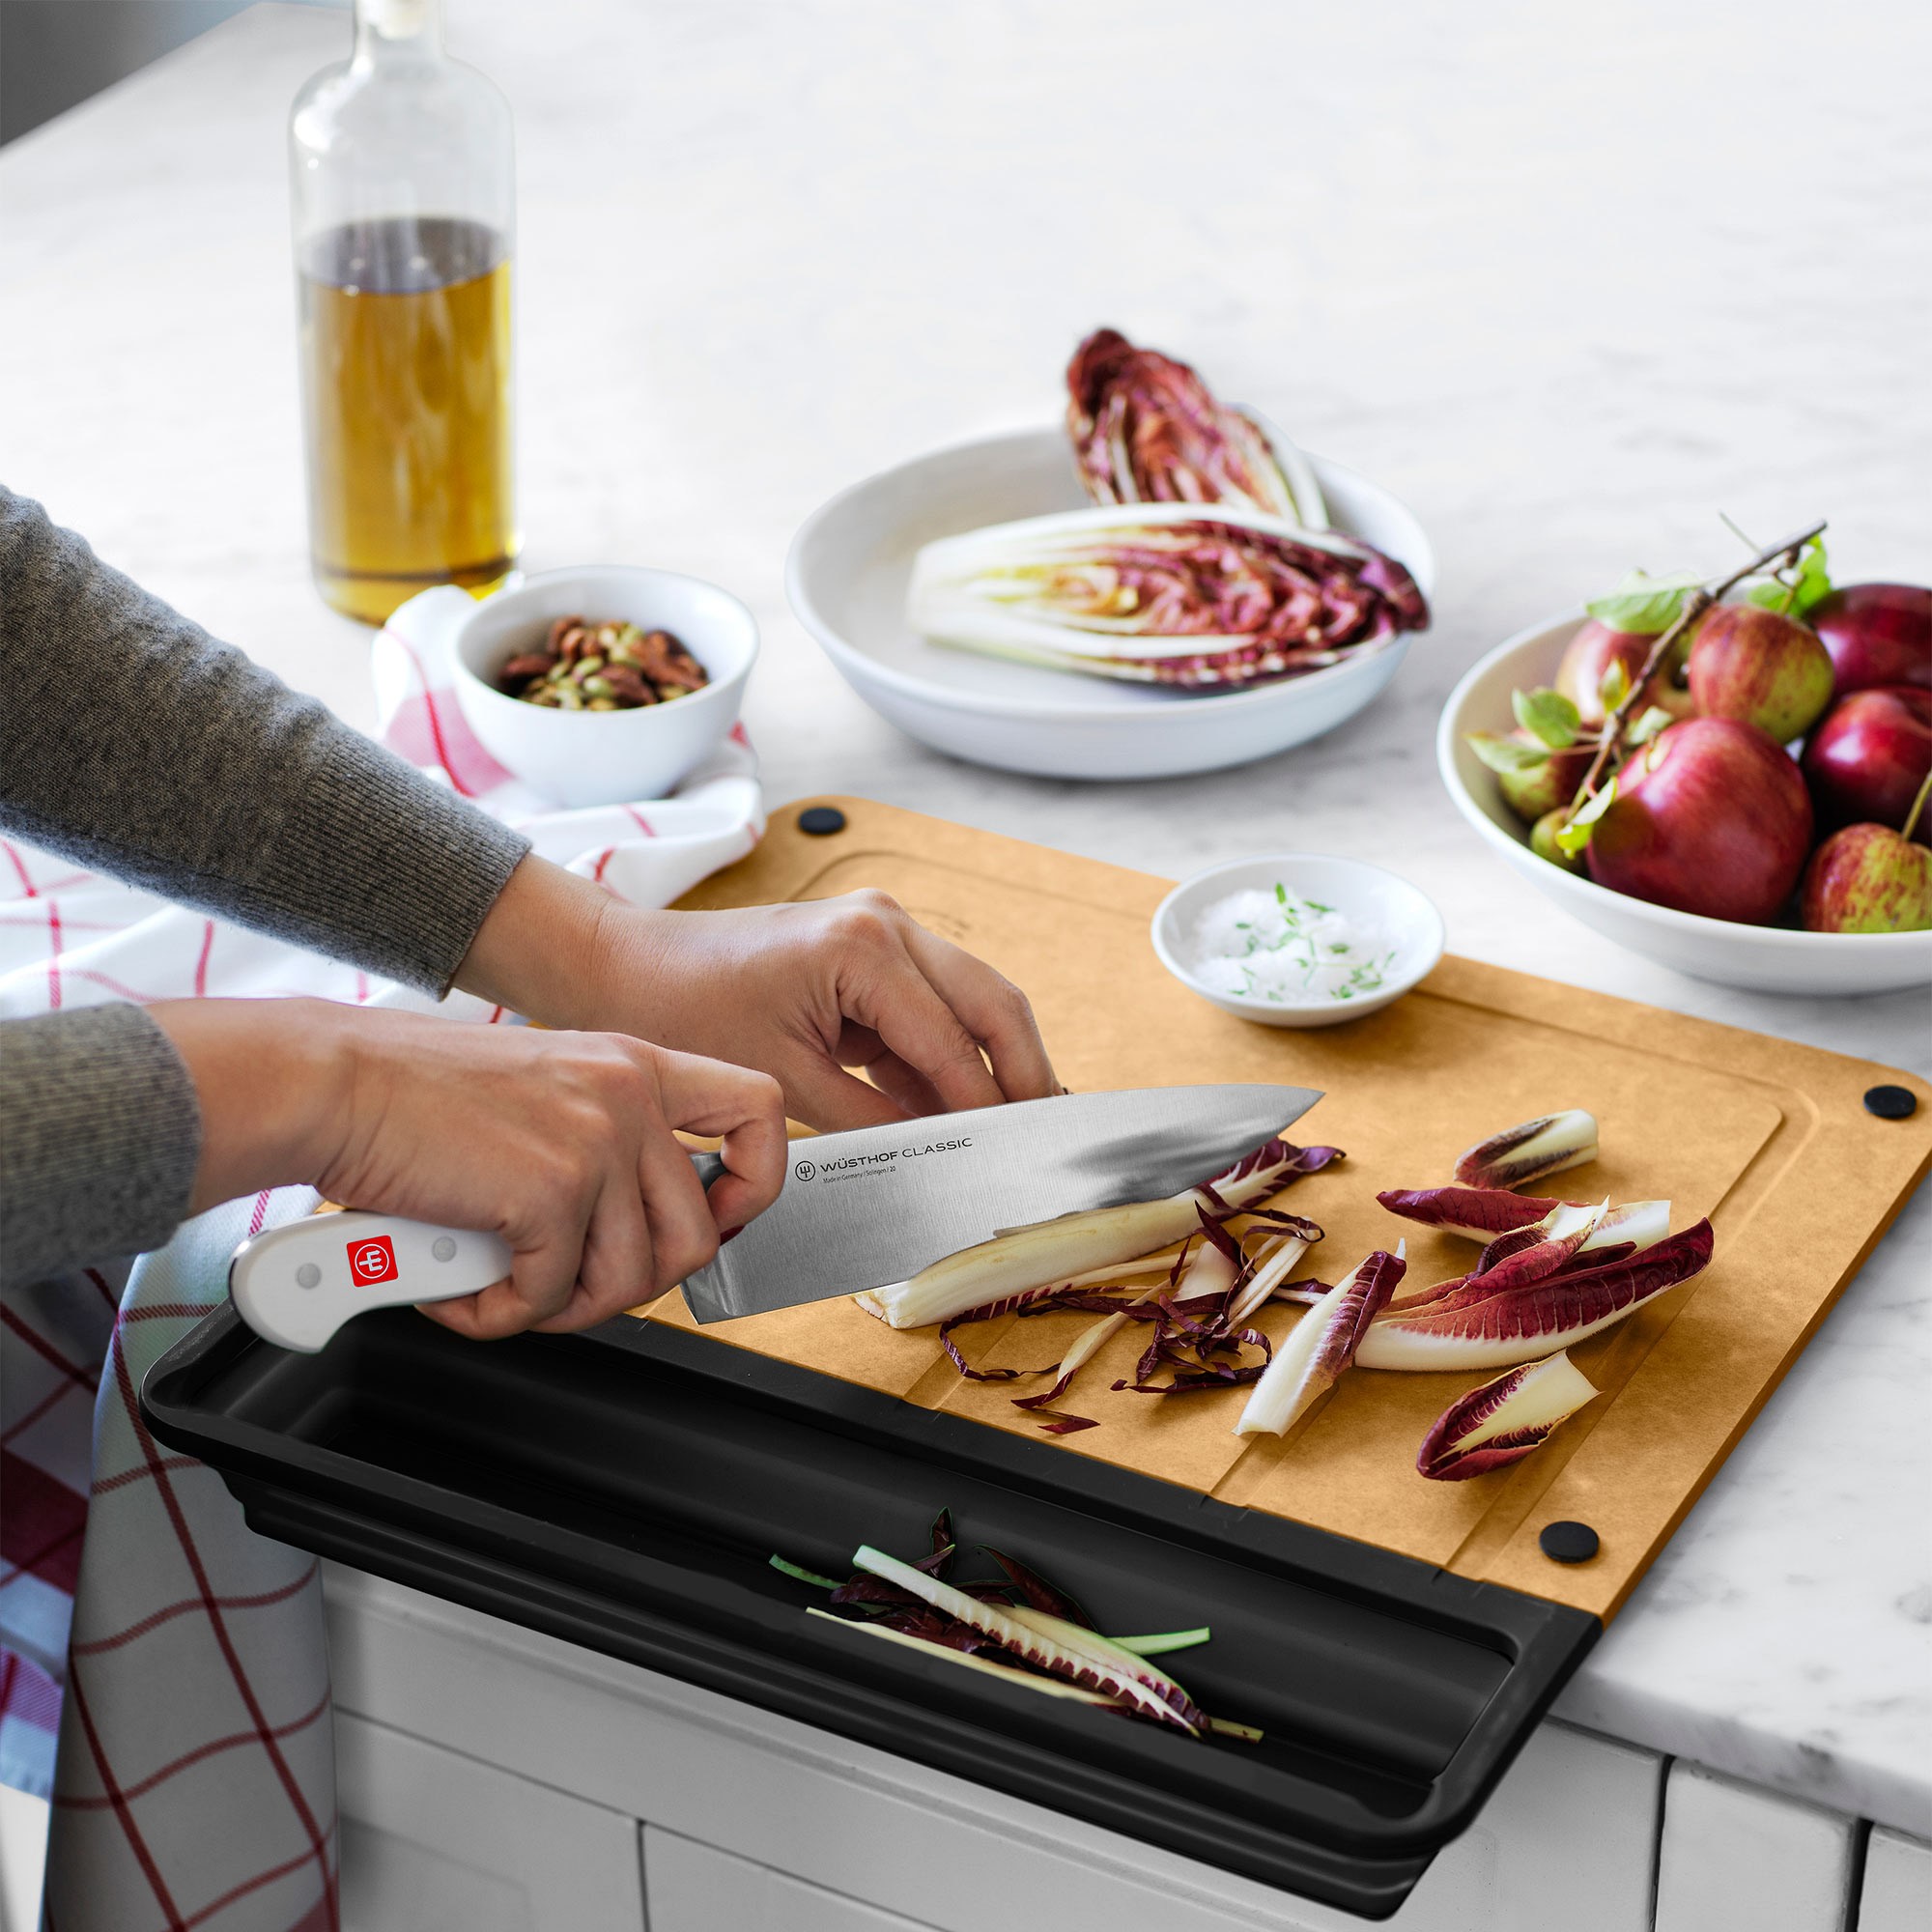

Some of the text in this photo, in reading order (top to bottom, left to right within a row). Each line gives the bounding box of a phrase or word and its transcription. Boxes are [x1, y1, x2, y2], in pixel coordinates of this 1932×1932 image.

[820, 1137, 973, 1173] WÜSTHOF CLASSIC
[841, 1172, 863, 1180] Germany
[866, 1167, 887, 1177] Solingen
